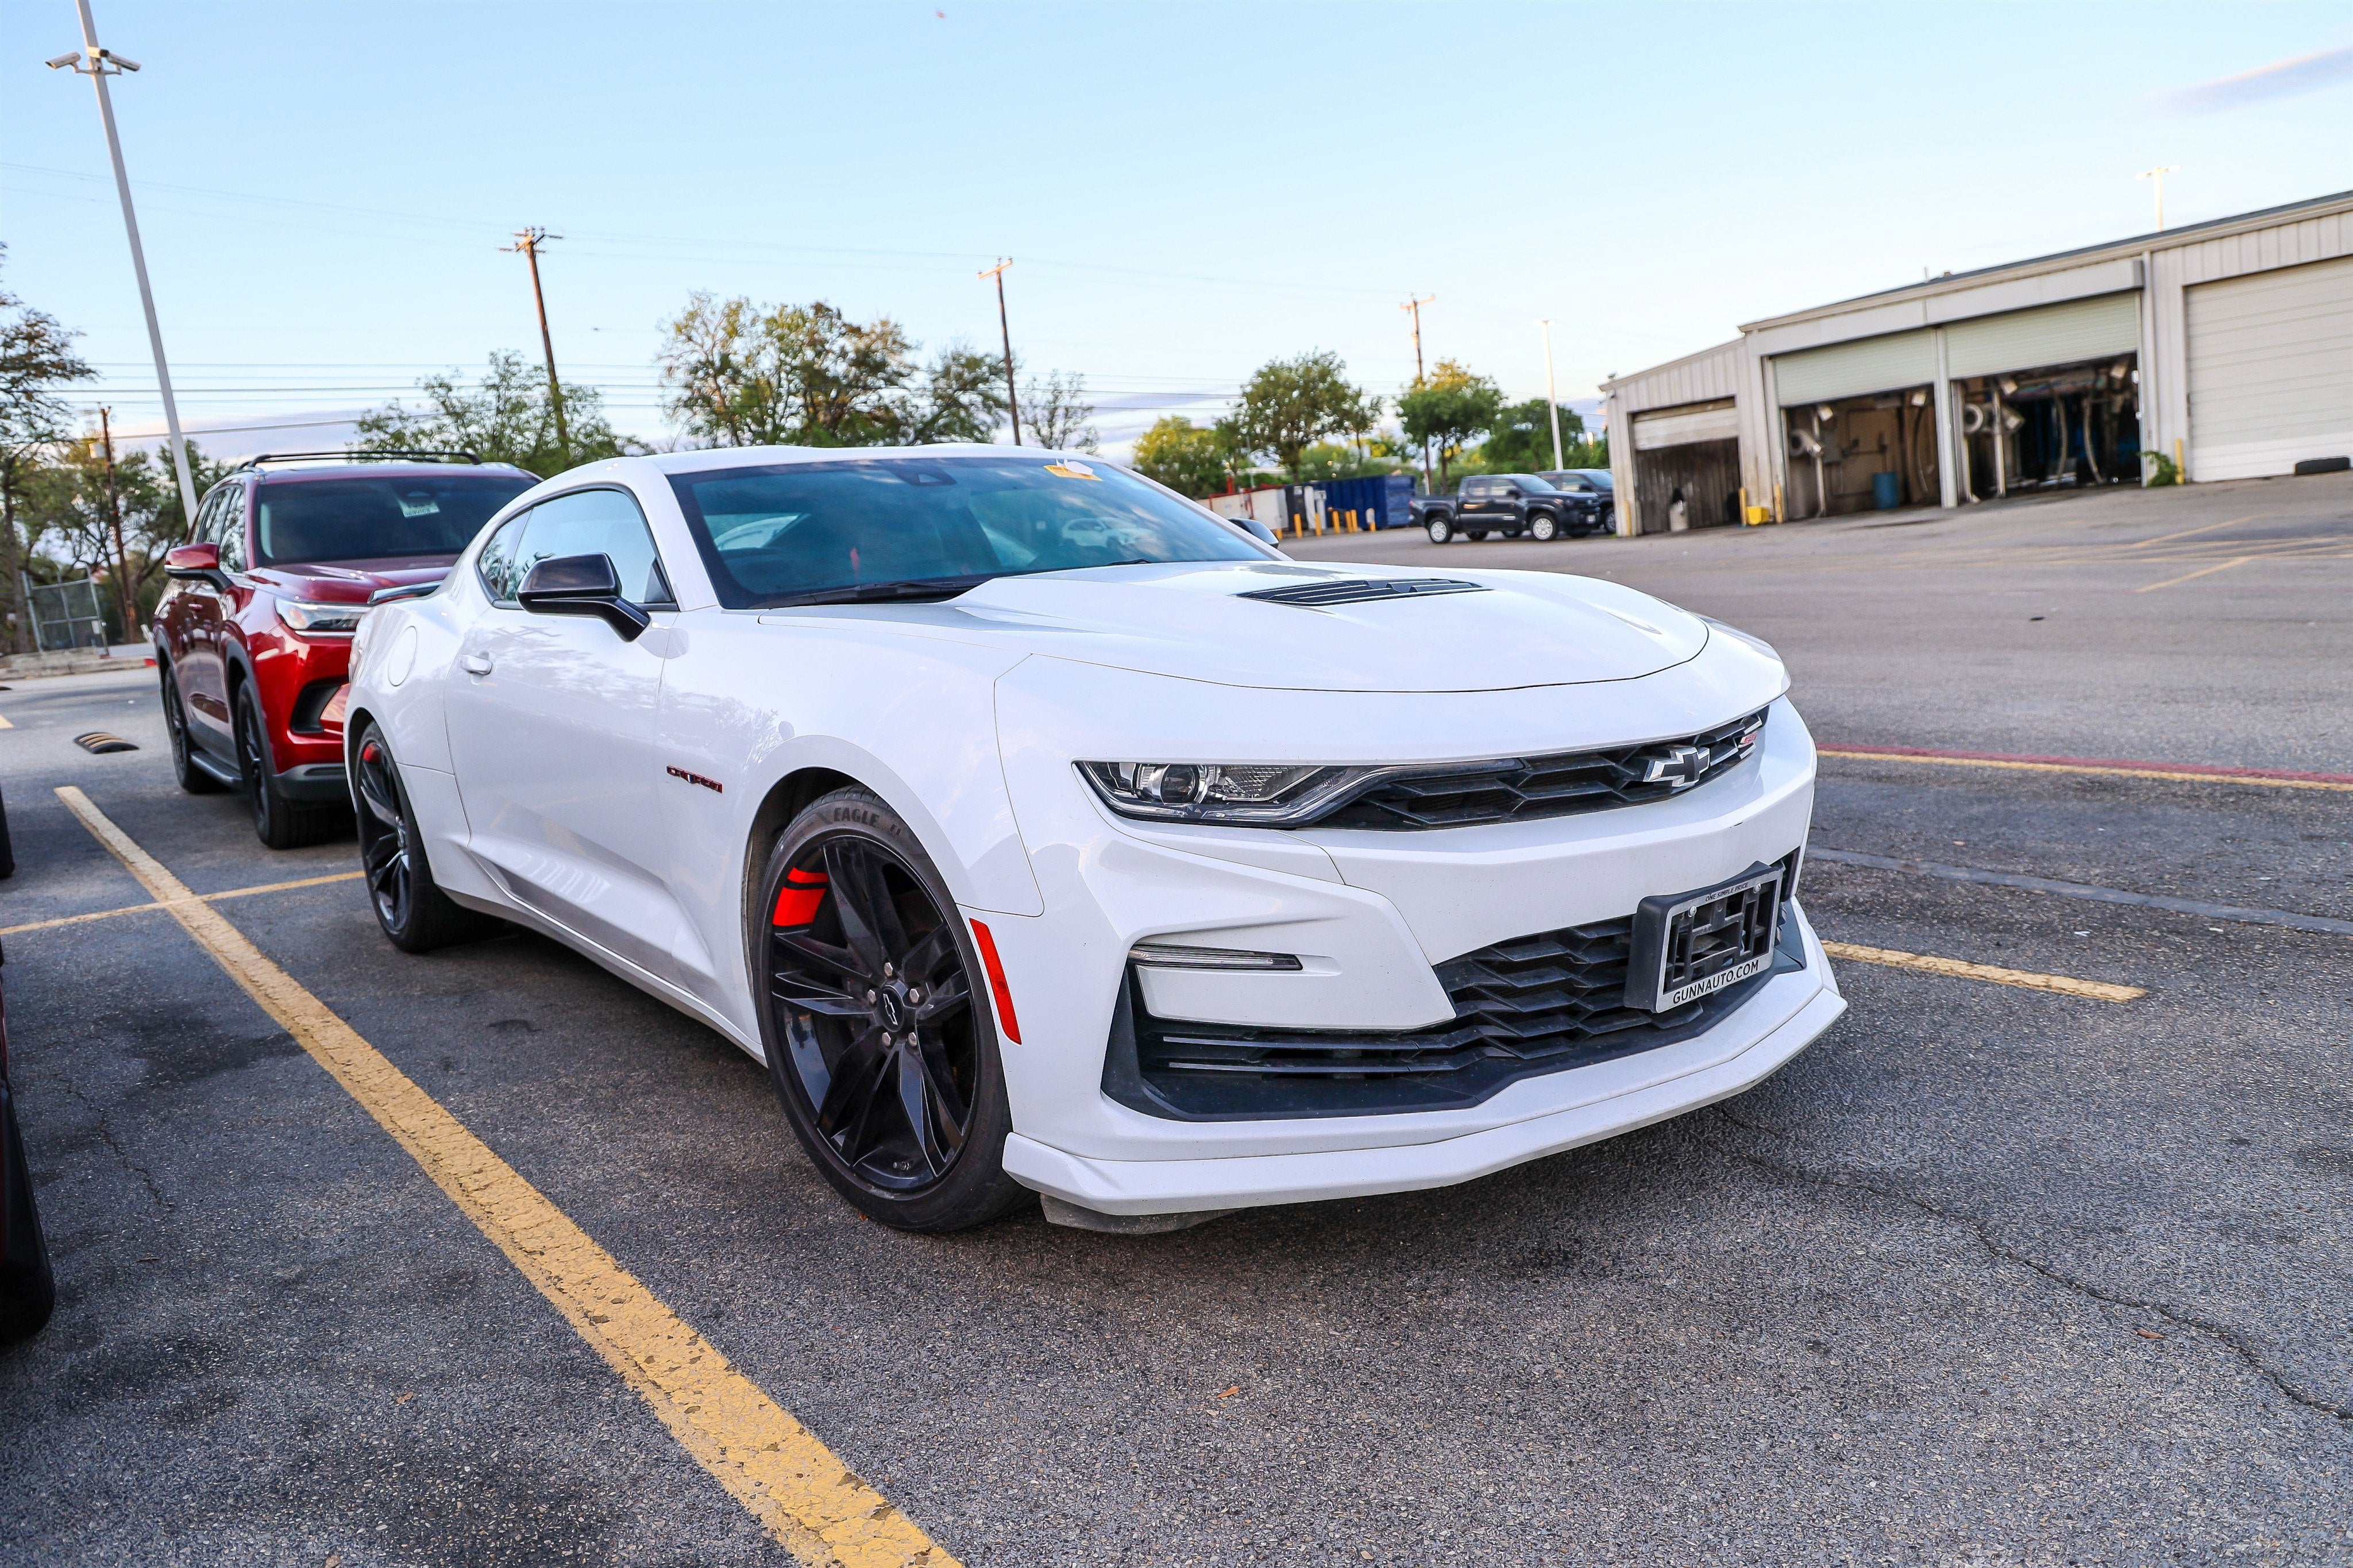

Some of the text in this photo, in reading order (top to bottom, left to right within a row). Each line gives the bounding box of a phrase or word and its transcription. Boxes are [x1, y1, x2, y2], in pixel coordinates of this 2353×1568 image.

[834, 807, 880, 828] EAGLE
[1706, 882, 1749, 902] ONE SIMPLE PRICE
[1673, 959, 1759, 1005] GUNNAUTO.COM
